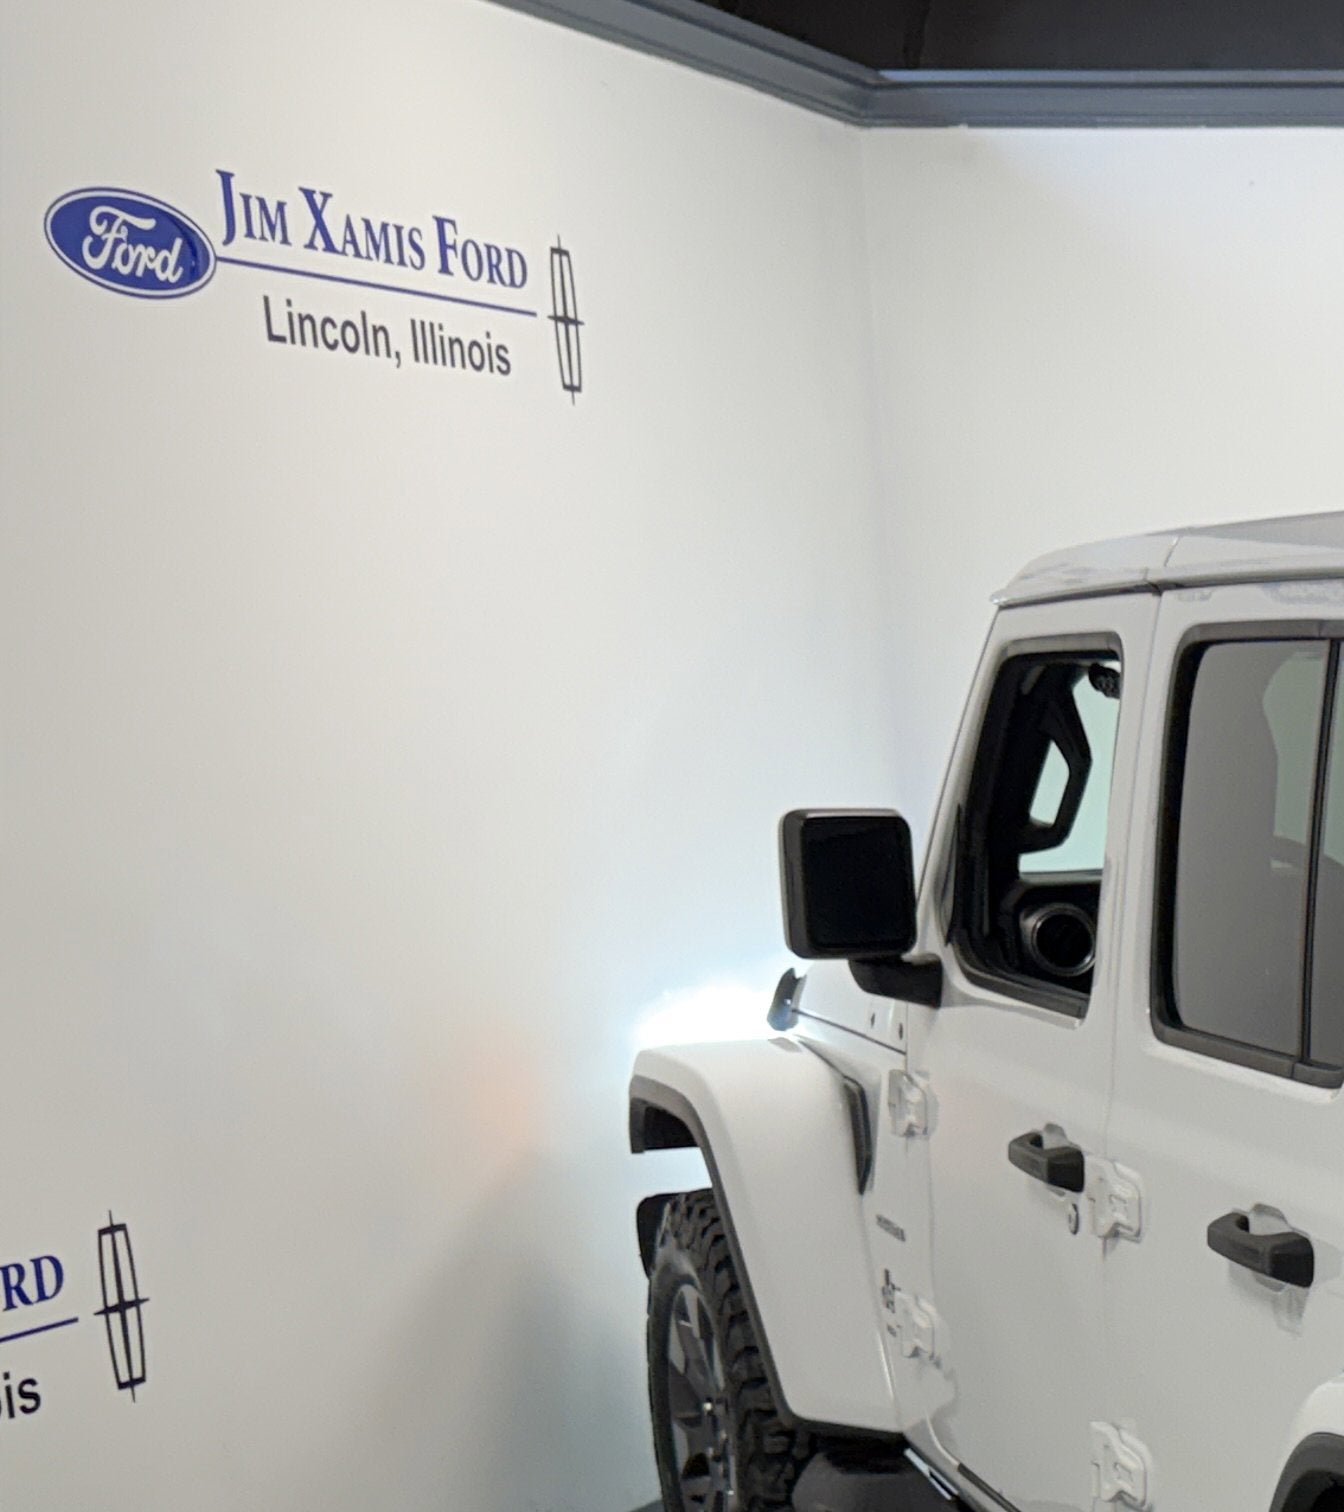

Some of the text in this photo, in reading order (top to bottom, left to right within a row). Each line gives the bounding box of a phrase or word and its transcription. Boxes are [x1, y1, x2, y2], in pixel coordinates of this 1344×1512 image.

[81, 205, 183, 284] Ford
[215, 169, 528, 289] JIM XAMIS FORD
[263, 295, 511, 376] Lincoln, Illinois
[0, 1255, 64, 1312] RD
